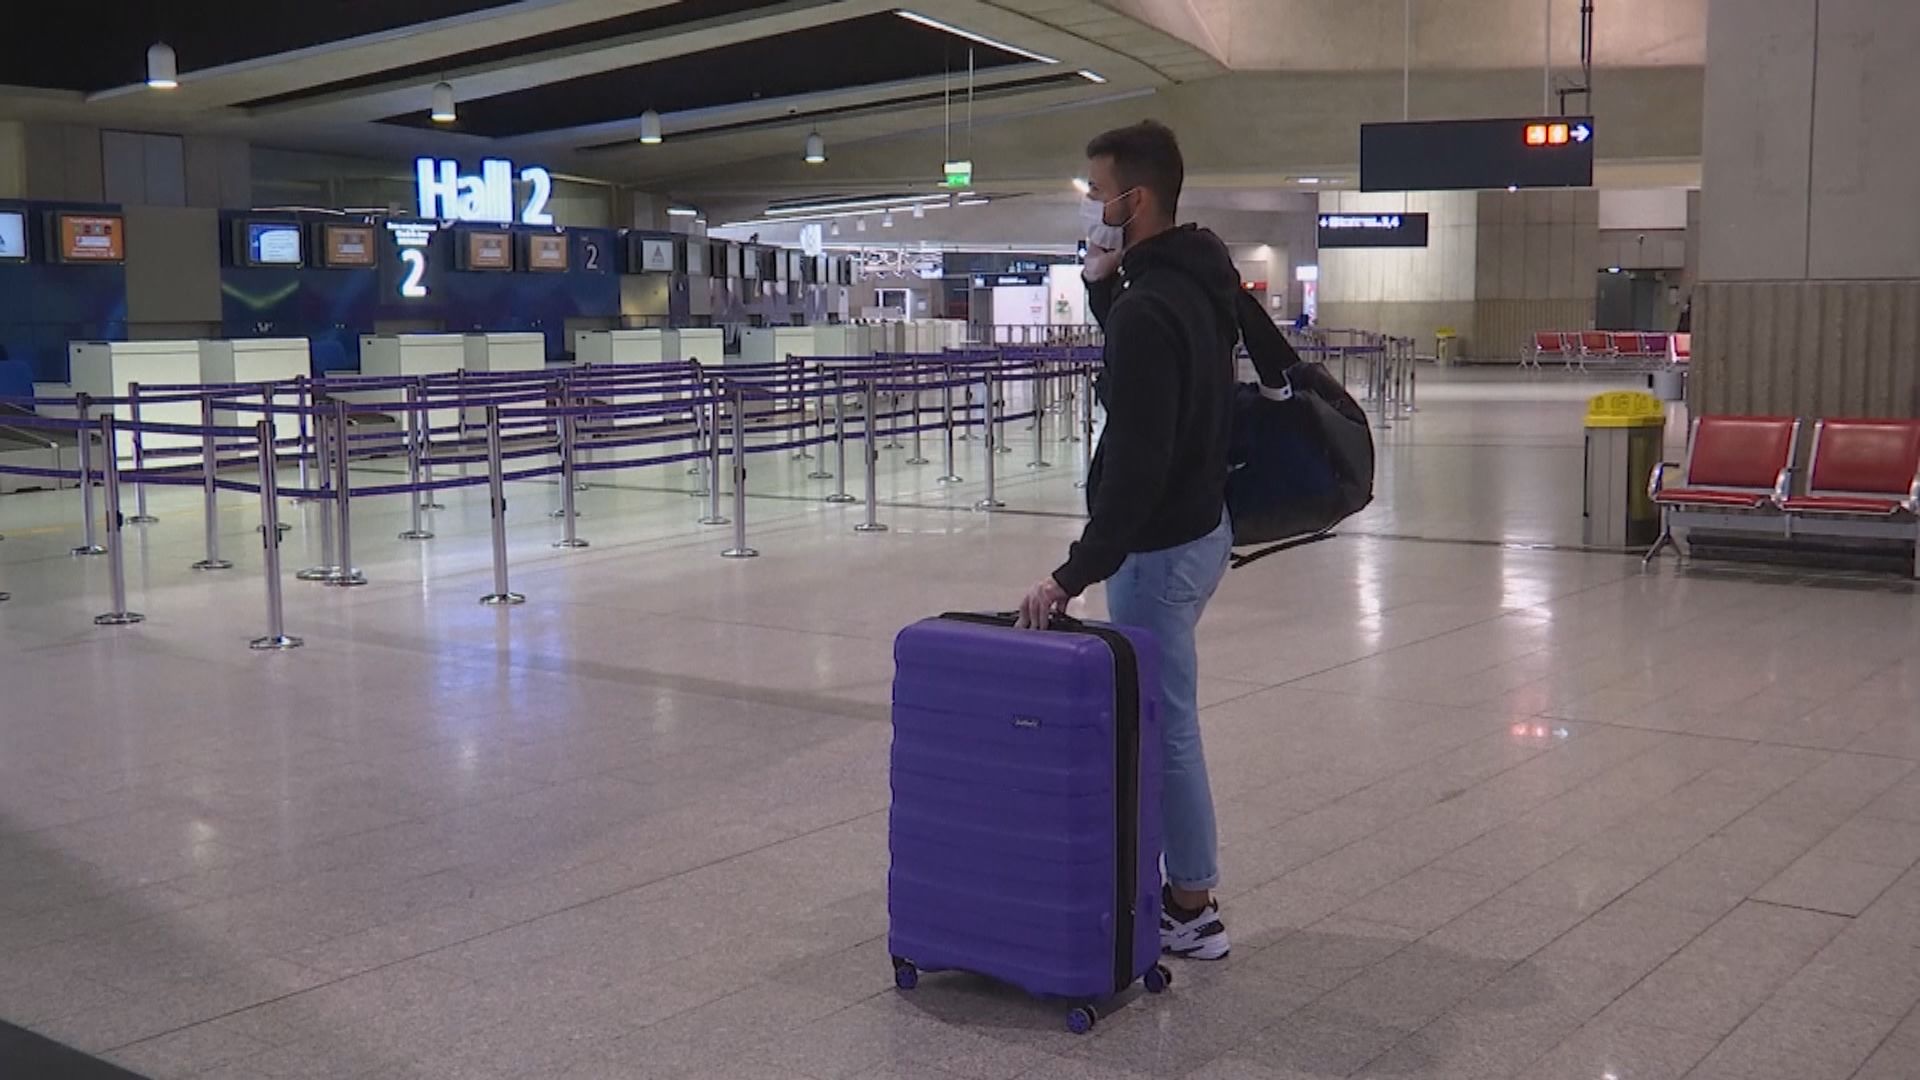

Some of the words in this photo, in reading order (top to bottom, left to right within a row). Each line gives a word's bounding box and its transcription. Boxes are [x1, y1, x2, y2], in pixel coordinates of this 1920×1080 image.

[417, 158, 513, 222] Hall
[521, 167, 553, 225] 2
[401, 249, 427, 297] 2
[585, 244, 598, 270] 2
